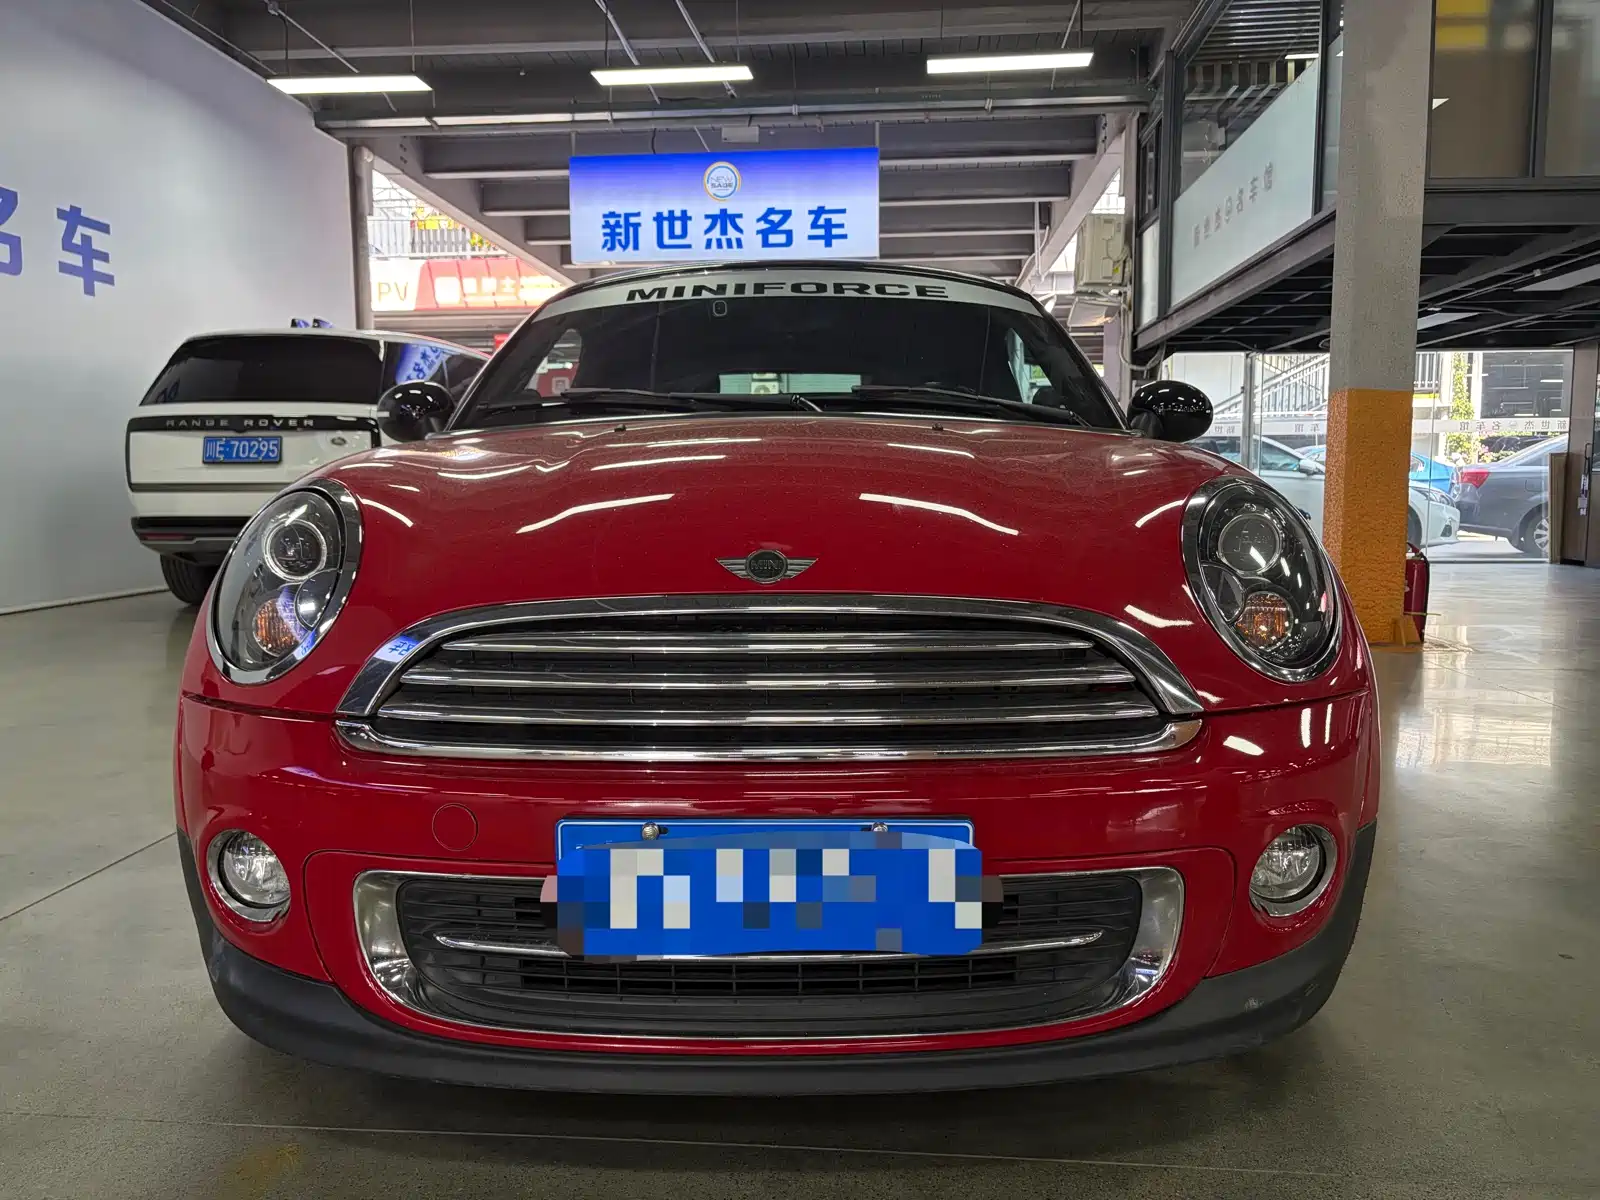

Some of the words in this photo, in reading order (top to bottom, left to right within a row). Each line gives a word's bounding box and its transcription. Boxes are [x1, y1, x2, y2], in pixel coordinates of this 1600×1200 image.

[601, 205, 848, 252] 新世杰名车
[626, 282, 949, 302] MINIFORCE
[166, 418, 230, 428] RANGE
[243, 418, 314, 427] ROVER
